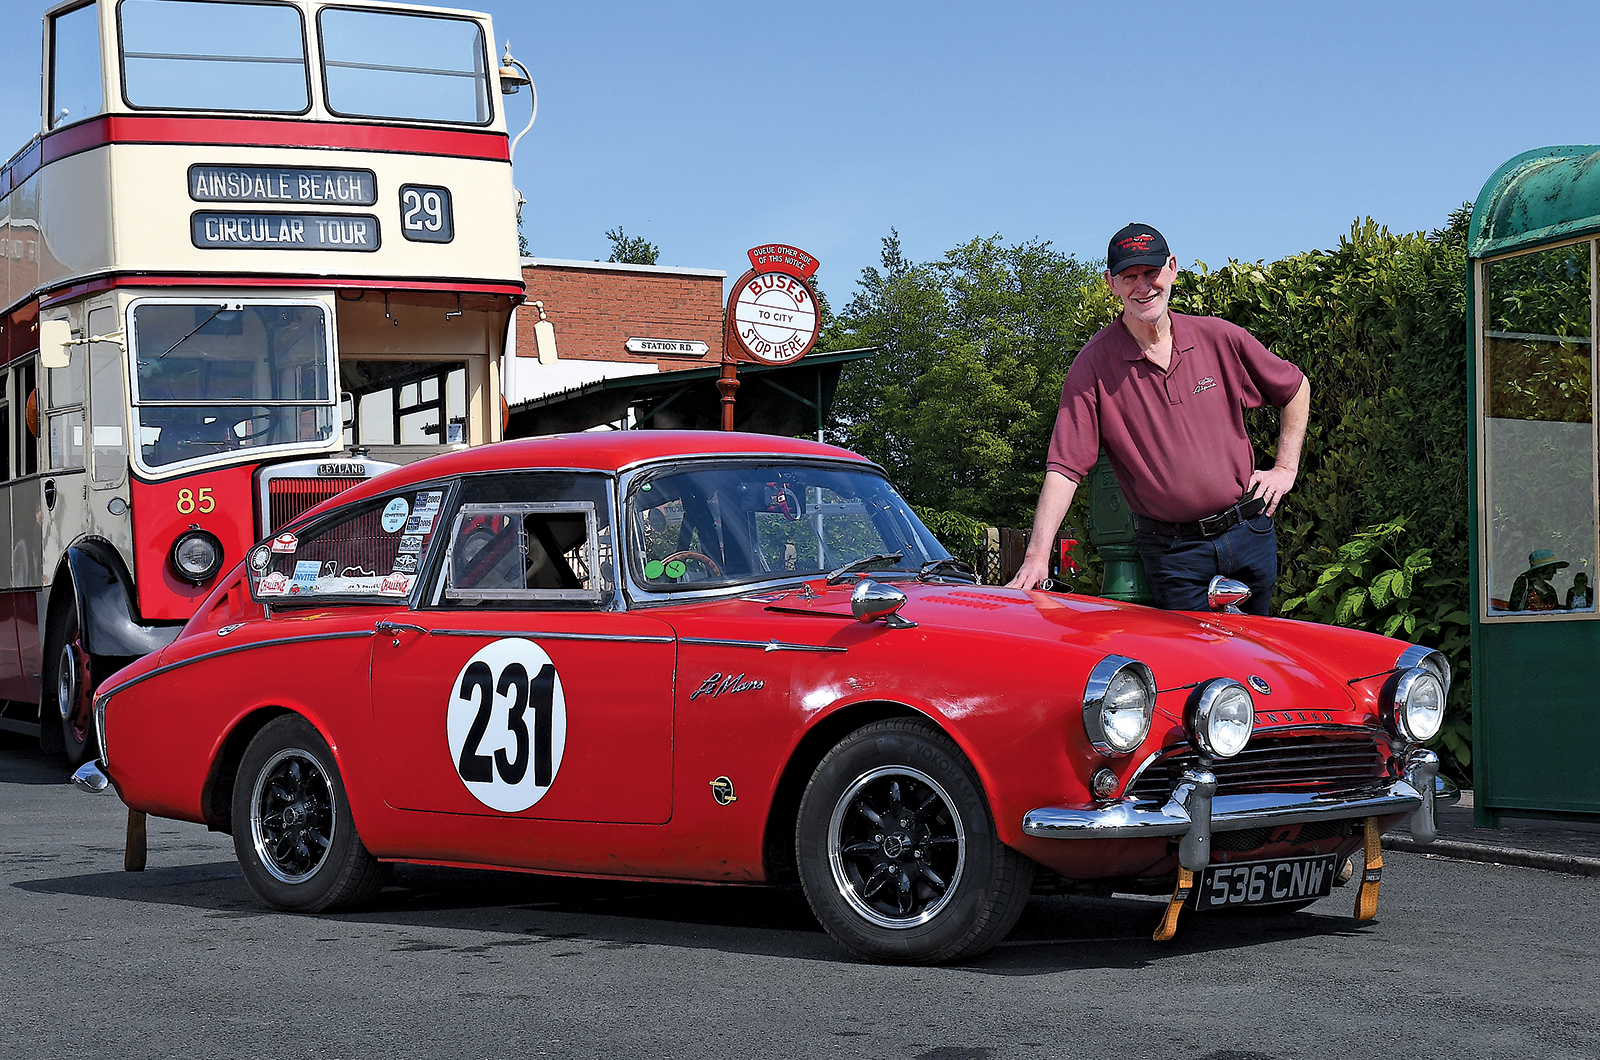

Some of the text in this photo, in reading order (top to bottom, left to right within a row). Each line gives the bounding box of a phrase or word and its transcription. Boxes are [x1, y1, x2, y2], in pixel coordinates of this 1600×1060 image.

[195, 170, 363, 201] AINSDALE BEACH
[403, 189, 443, 233] 29
[204, 217, 367, 245] CIRCULAR TOUR
[753, 246, 813, 265] QUEUE OTHER SIDE
[758, 255, 807, 271] OF THIS NOTICE
[748, 274, 808, 304] BUSES
[758, 310, 794, 323] TO CITY
[641, 341, 694, 352] STATION RD.
[741, 328, 806, 359] STOP HERE
[176, 487, 216, 515] 85
[689, 672, 765, 701] Le Mans
[458, 660, 556, 787] 231
[1254, 712, 1334, 725] UNBEAM
[914, 742, 978, 812] YOKOHAMA
[1210, 860, 1327, 905] 536 CNW
